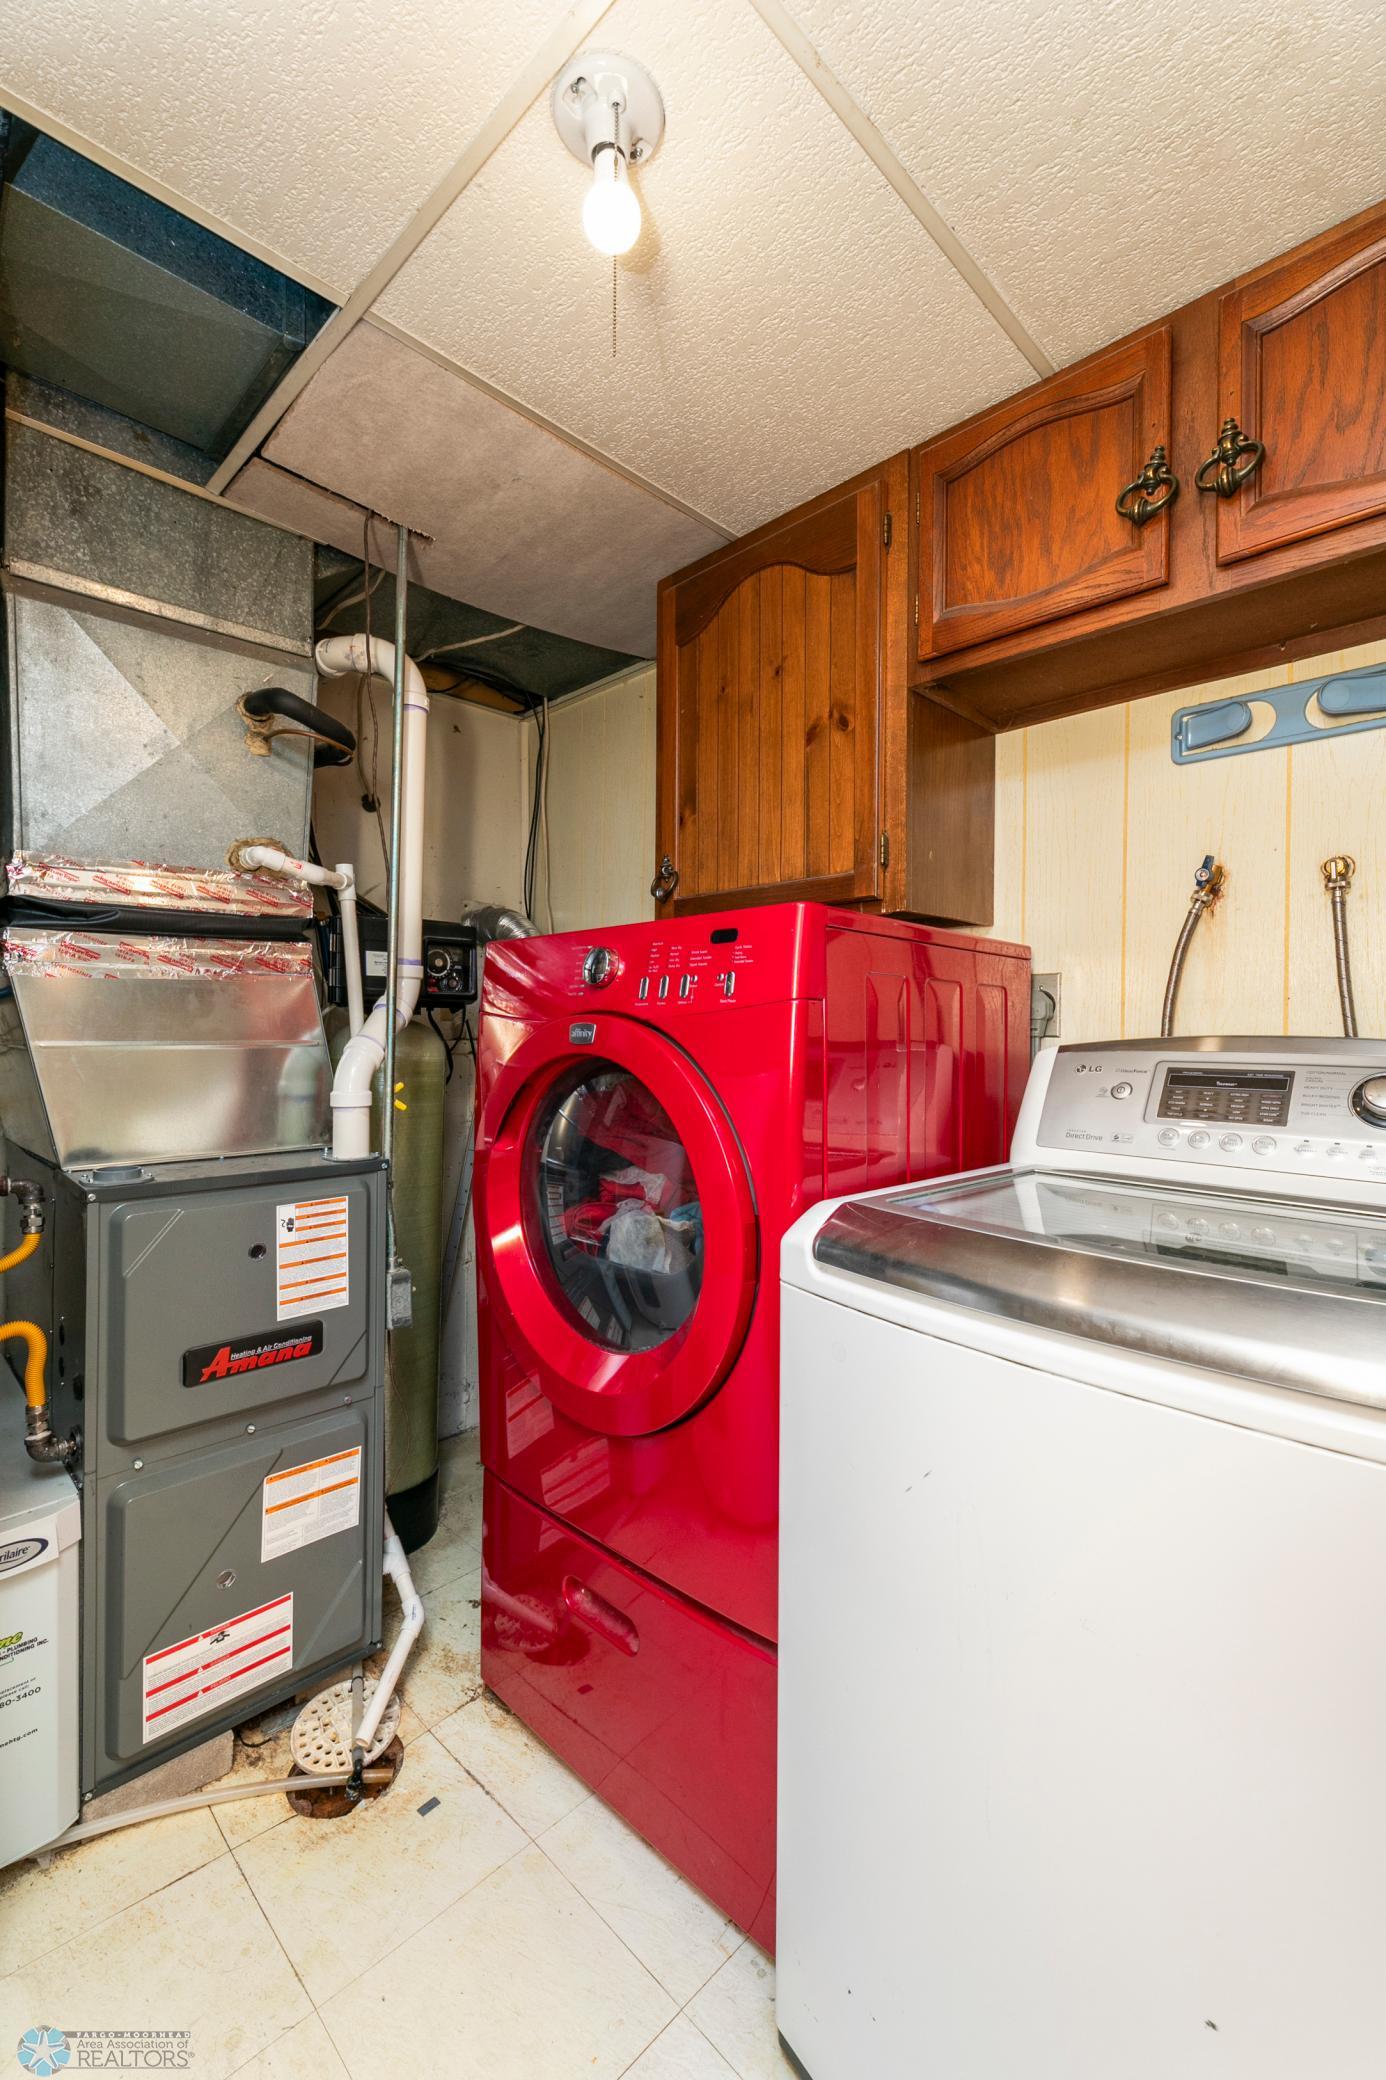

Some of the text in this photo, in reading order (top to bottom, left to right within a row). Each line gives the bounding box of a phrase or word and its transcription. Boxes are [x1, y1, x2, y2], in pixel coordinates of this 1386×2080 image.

[1088, 1065, 1103, 1073] LG
[231, 1335, 313, 1361] Heating & Air Conditioning
[200, 1341, 313, 1382] Amana
[7, 1636, 38, 1653] PLUMBING
